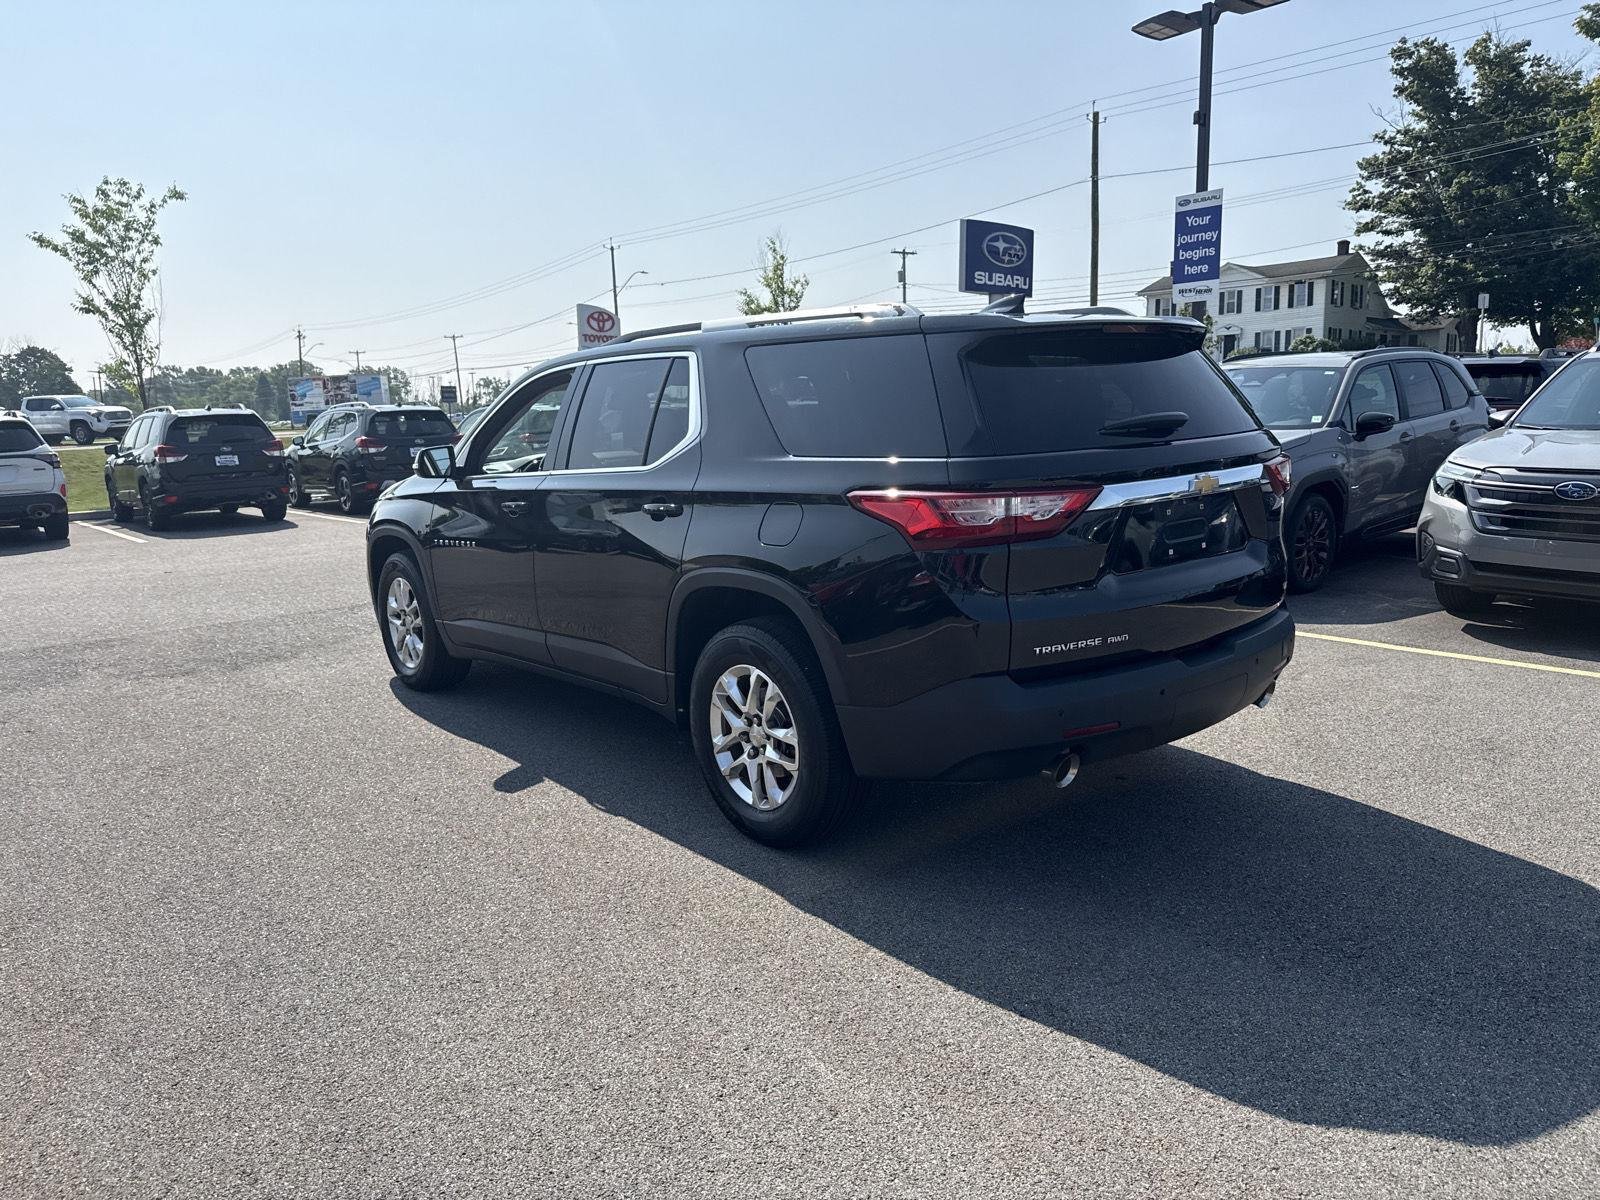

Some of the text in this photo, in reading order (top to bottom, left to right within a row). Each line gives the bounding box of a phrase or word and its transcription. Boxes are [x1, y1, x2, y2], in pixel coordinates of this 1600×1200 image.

[1192, 195, 1221, 204] SUBARU
[1186, 215, 1211, 227] Your
[1176, 230, 1219, 247] journey
[1179, 246, 1216, 261] begins
[1184, 263, 1209, 275] here
[974, 270, 1029, 290] SUBARU
[582, 334, 618, 343] TOYOT
[1033, 633, 1129, 655] TRAVERSE AWD
